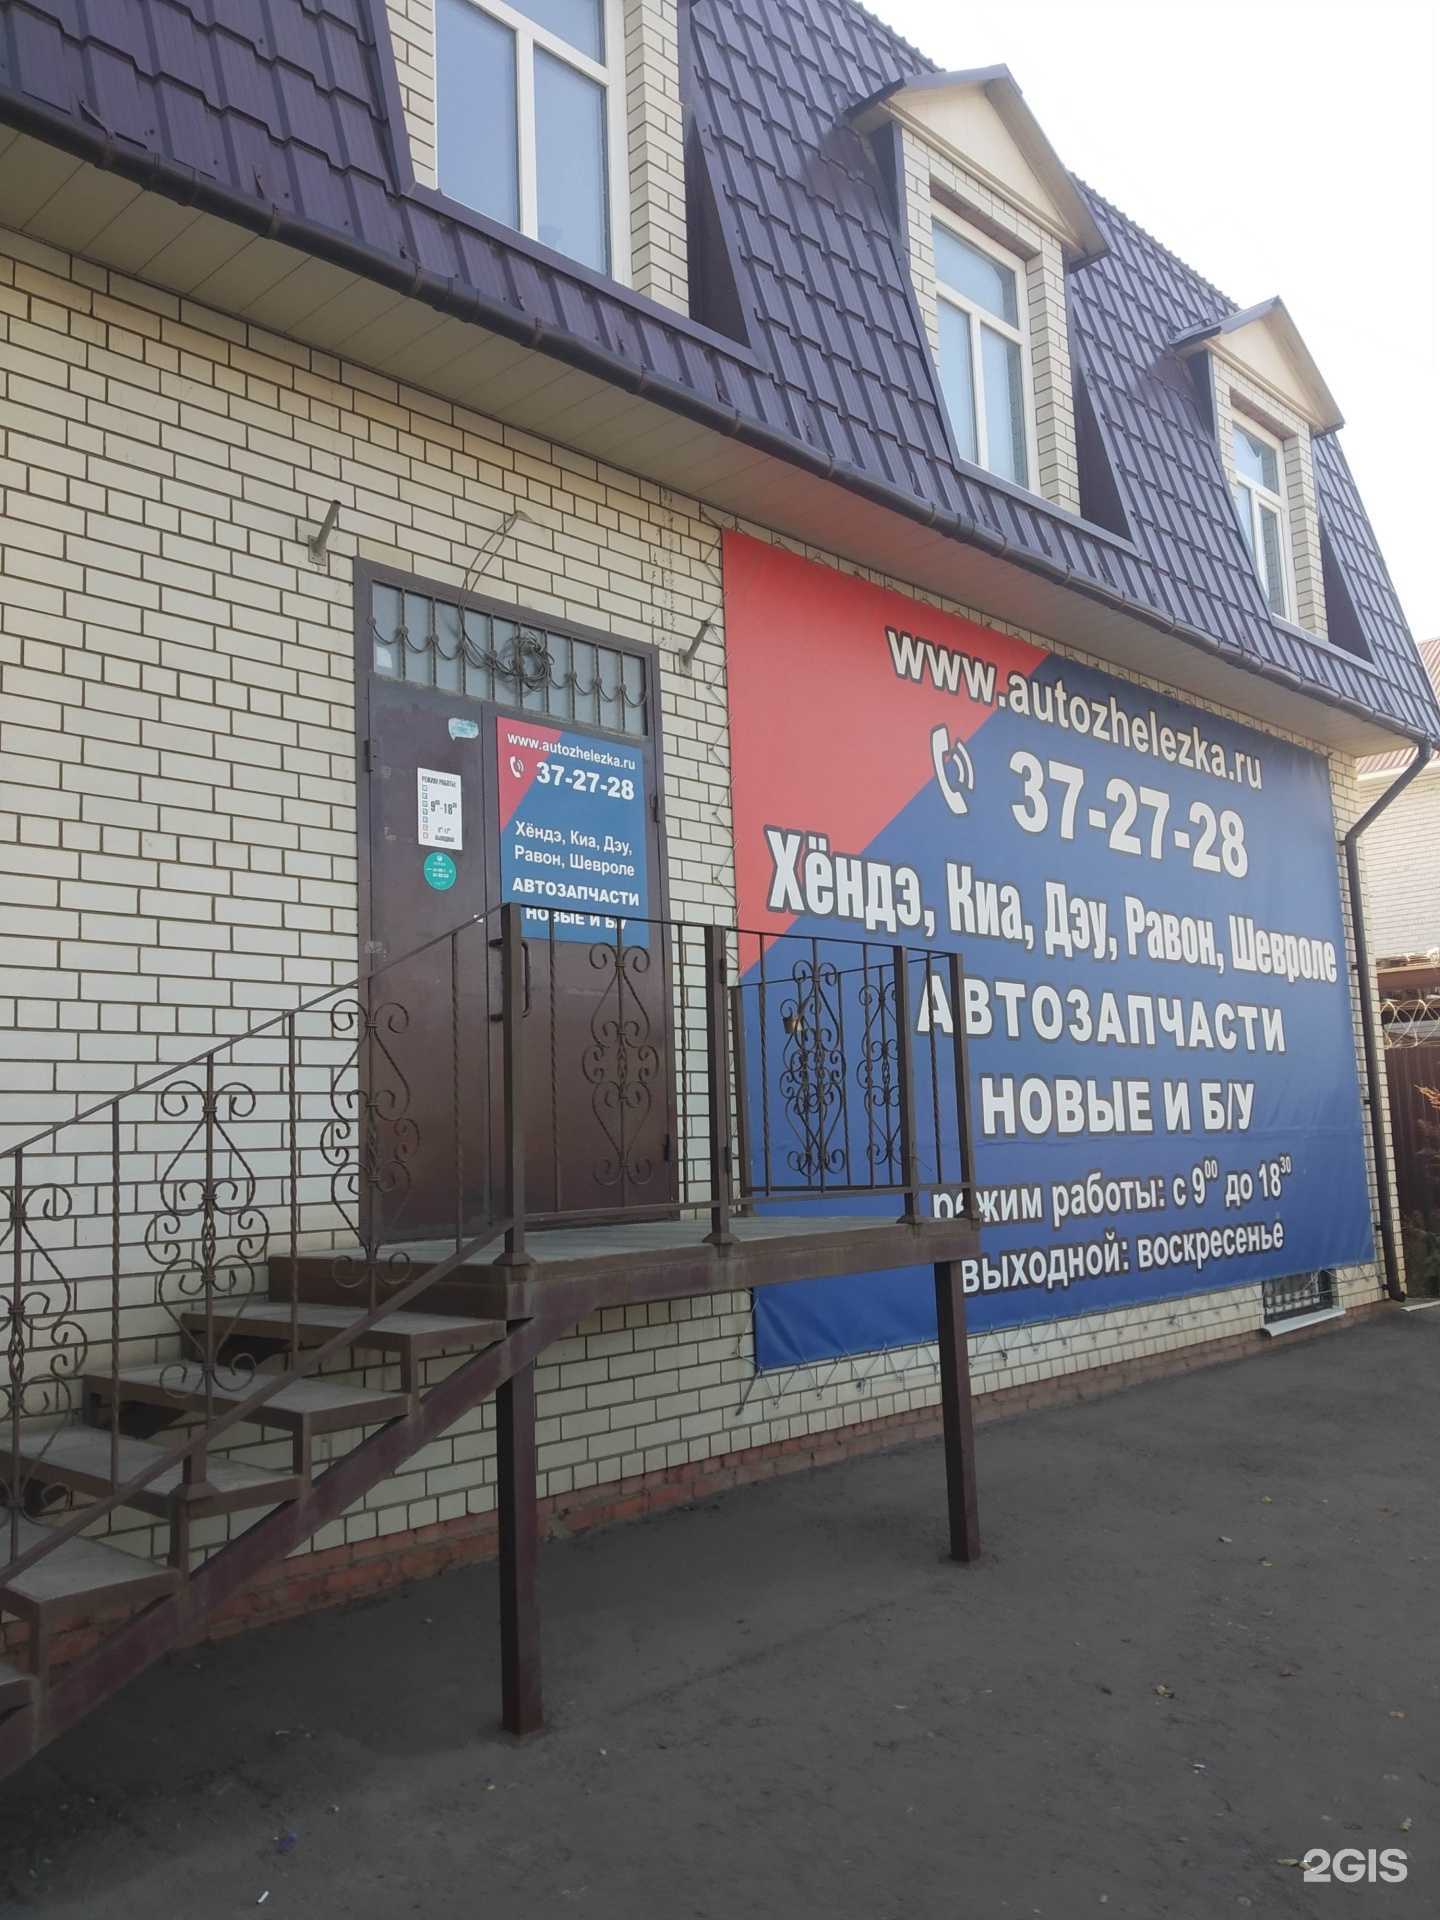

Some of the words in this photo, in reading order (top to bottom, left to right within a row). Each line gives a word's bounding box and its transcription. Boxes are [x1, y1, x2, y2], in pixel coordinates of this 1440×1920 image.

[887, 629, 1263, 790] www.autozhelezka.ru
[507, 733, 636, 770] www.autozhelezka.ru
[536, 761, 635, 801] 37-27-28
[515, 820, 566, 846] Хёндэ,
[570, 830, 600, 851] Киа,
[604, 835, 633, 857] Дэу,
[1009, 751, 1249, 879] 37-27-28
[514, 844, 565, 869] Равон,
[569, 853, 635, 877] Шевроле
[512, 877, 640, 907] АВТОЗАПЧАСТИ
[767, 829, 936, 938] Хёндэ,
[946, 862, 1033, 957] Киа,
[1044, 881, 1117, 962] Дэу,
[1124, 896, 1224, 975] Равон,
[1229, 915, 1338, 984] Шевроле
[916, 975, 1286, 1052] АВТОЗАПЧАСТИ
[980, 1077, 1153, 1134] НОВЫЕ
[1163, 1081, 1191, 1131] И
[1200, 1082, 1255, 1131] Б/У
[1051, 1172, 1165, 1227] работы:
[1172, 1176, 1187, 1206] с
[1225, 1174, 1254, 1207] до
[961, 1232, 1129, 1294] выходной:
[1137, 1220, 1284, 1270] воскресенье
